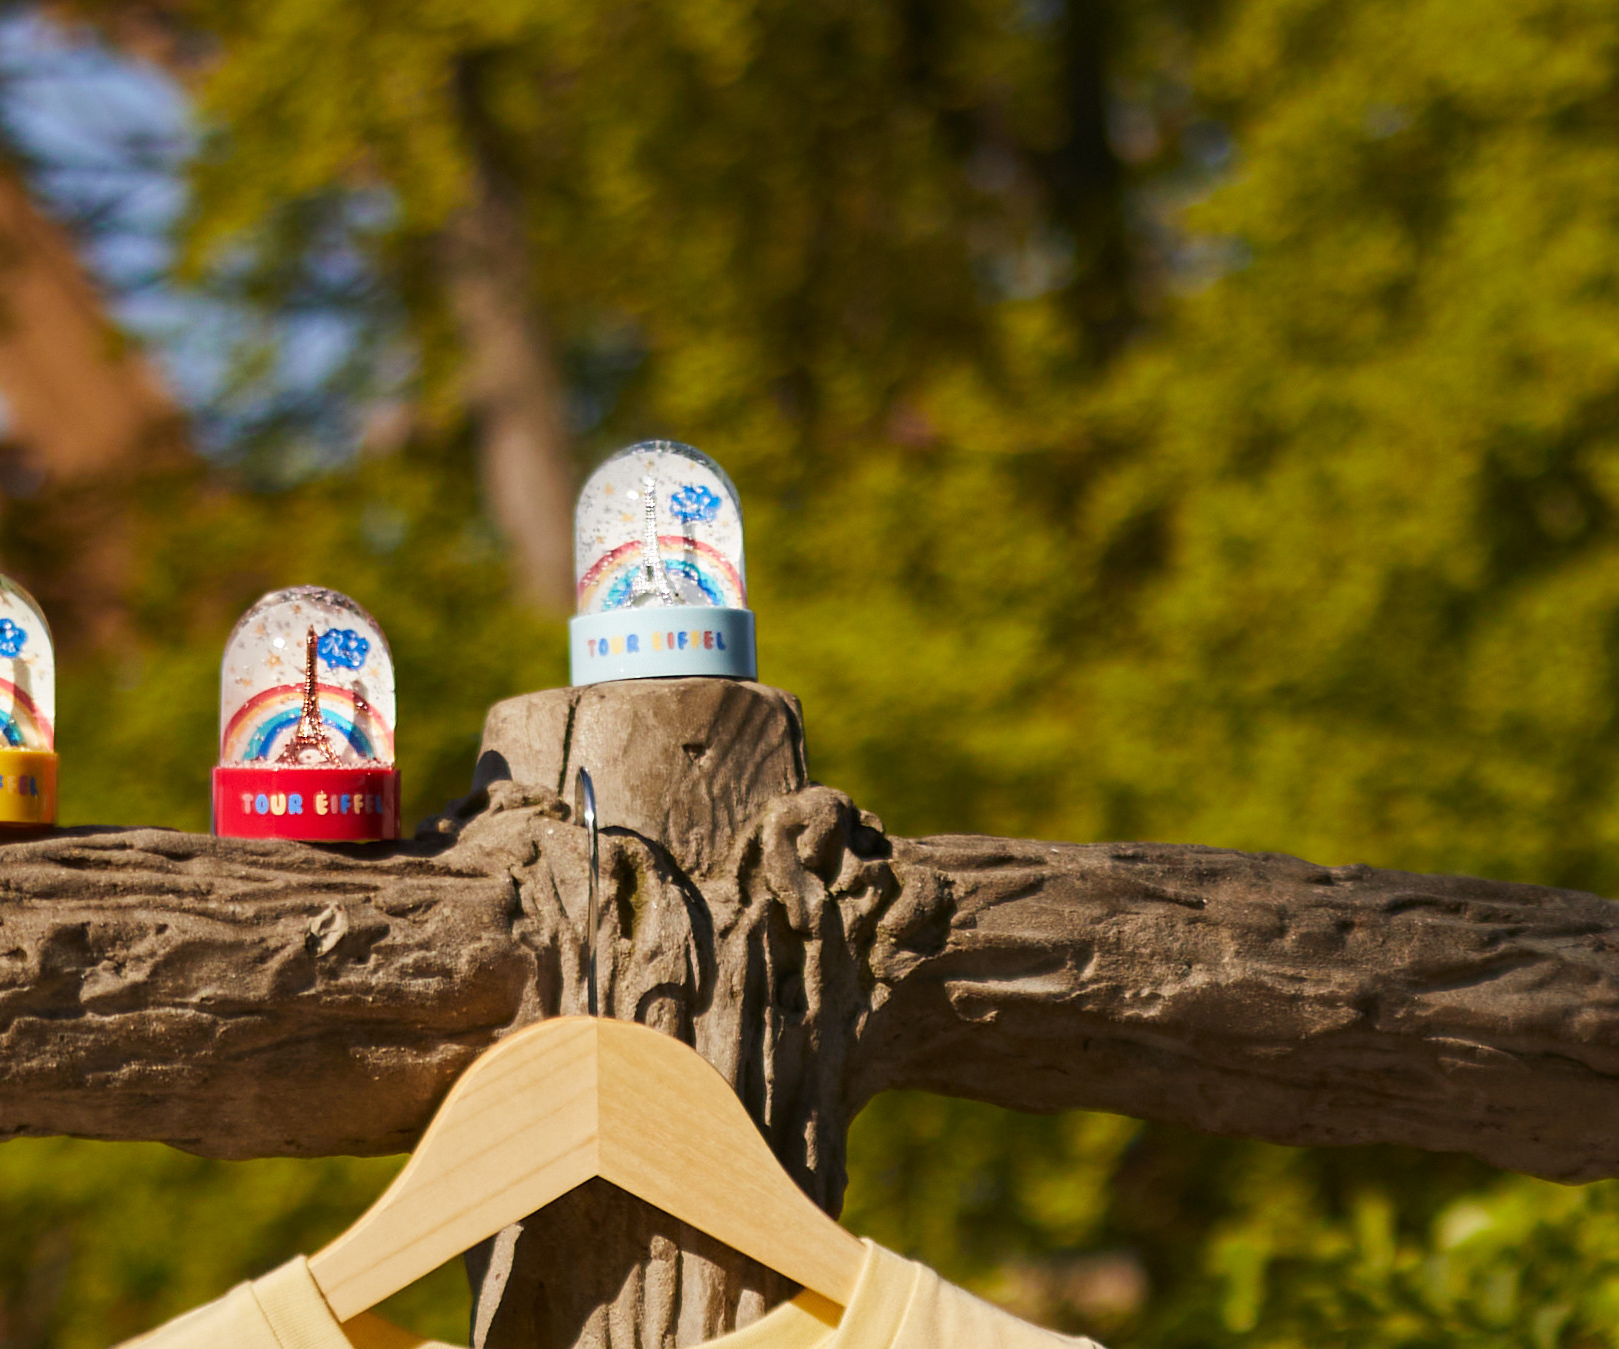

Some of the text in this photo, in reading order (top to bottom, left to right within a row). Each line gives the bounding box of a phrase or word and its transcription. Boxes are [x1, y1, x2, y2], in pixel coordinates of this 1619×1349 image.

[588, 630, 727, 658] TOUR EIFFEL
[242, 793, 383, 816] TOUR EIFFEL
